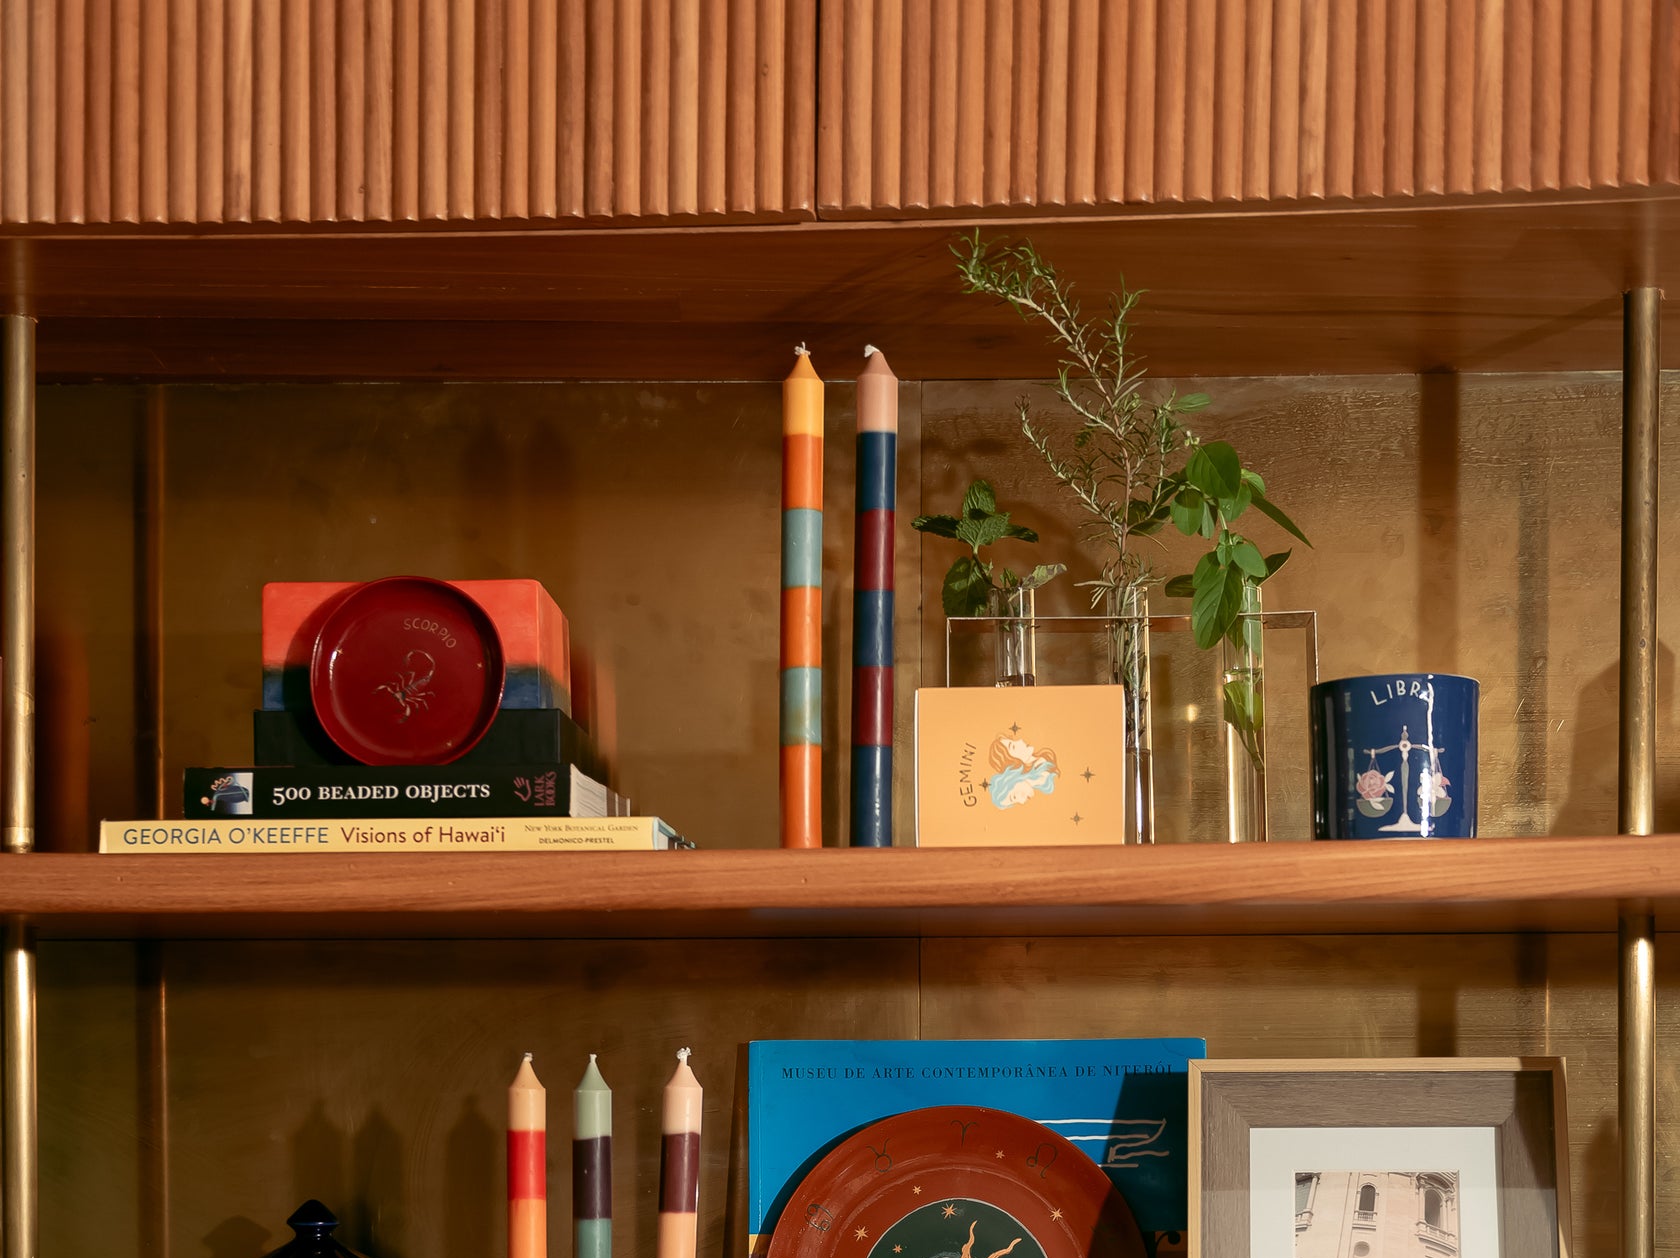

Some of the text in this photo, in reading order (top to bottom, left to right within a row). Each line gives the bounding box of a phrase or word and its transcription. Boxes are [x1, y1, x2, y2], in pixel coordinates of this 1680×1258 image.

[403, 617, 457, 648] SCORPIO
[959, 742, 977, 808] GEMINI
[272, 784, 491, 806] 500 BEADED OBJECTS
[534, 776, 545, 807] LARK
[545, 771, 557, 807] BOOKS
[123, 828, 222, 844] GEORGIA
[340, 826, 407, 843] Visions
[413, 826, 434, 843] of
[781, 1061, 1173, 1079] MUSEU DE ARTE CONTEMPORÂNEA DE NITERÓI
